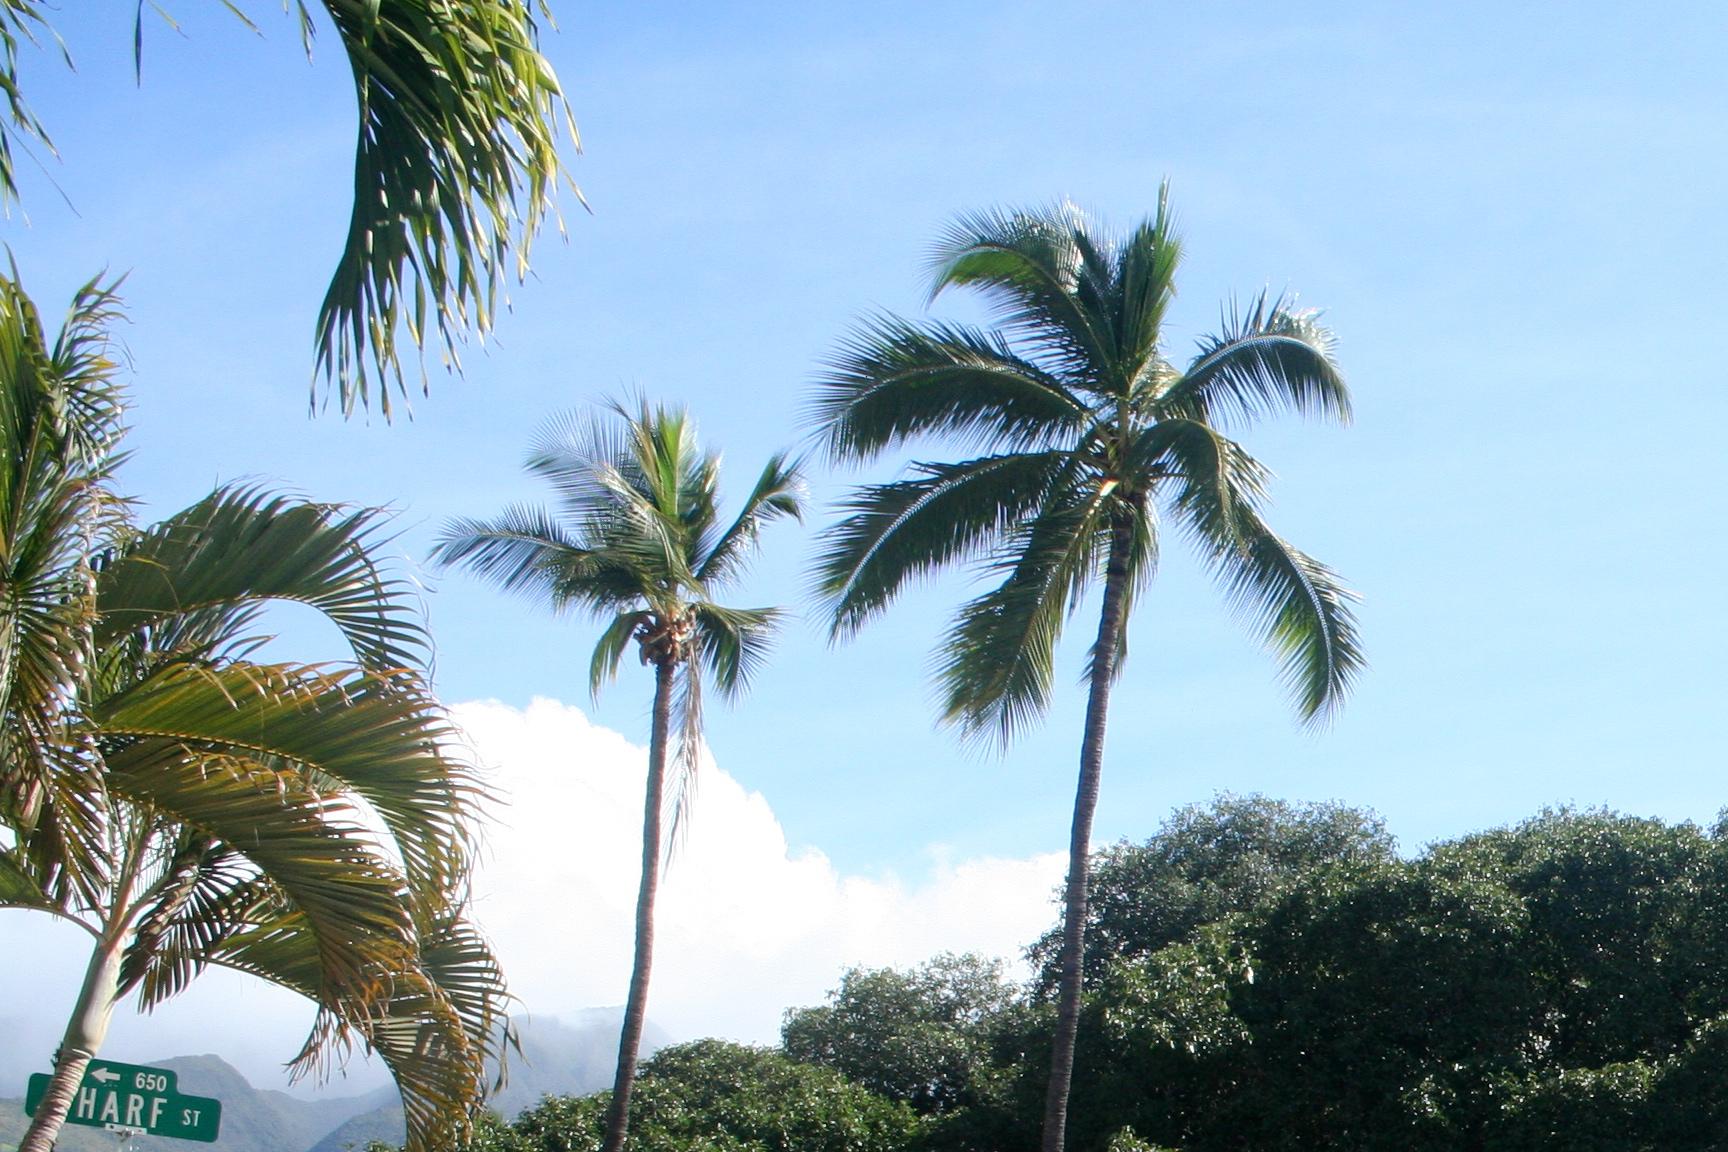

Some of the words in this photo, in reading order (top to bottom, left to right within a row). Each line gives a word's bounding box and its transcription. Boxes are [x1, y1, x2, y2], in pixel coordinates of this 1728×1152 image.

[135, 1072, 167, 1092] 650
[77, 1087, 168, 1128] HARF
[182, 1109, 201, 1127] ST
